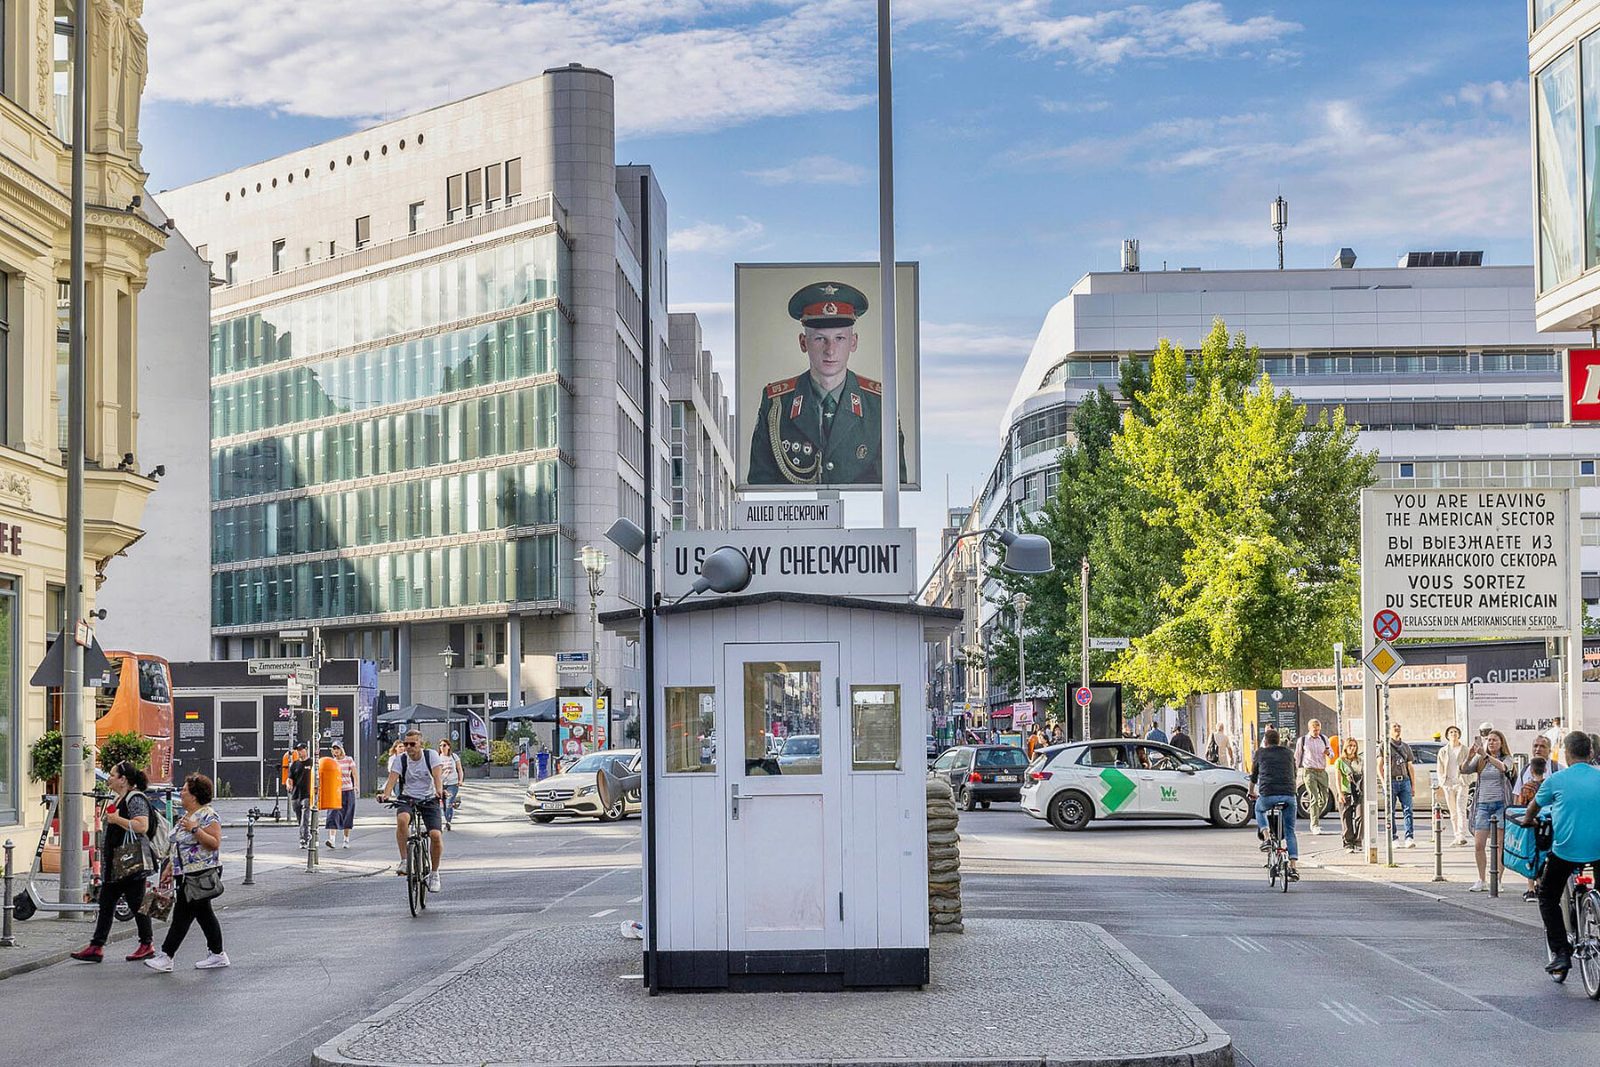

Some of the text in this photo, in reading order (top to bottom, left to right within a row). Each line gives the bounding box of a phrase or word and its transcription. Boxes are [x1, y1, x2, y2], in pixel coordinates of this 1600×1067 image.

[1393, 492, 1546, 509] YOU ARE LEAVING
[746, 504, 829, 522] ALLIED CHECKPOINT
[1385, 511, 1555, 526] THE AMERICAN SECTOR
[1388, 535, 1553, 550] ВЫ ВЫЕЗЖАЕТЕ ИЗ
[675, 546, 688, 575] U
[780, 544, 901, 575] CHECKPOINT
[1384, 553, 1558, 568] АМЕРИКАНСКОГО СЕКТОРА
[1407, 574, 1526, 590] VOUS SORTEZ
[1386, 591, 1557, 608] DU SECTEUR AMÉRICAIN
[1444, 615, 1459, 626] DEN
[1461, 615, 1527, 626] AMERIKANISCHEN
[1528, 615, 1557, 626] SEKTOR
[1403, 668, 1457, 681] BlackBox
[1160, 785, 1177, 797] We
